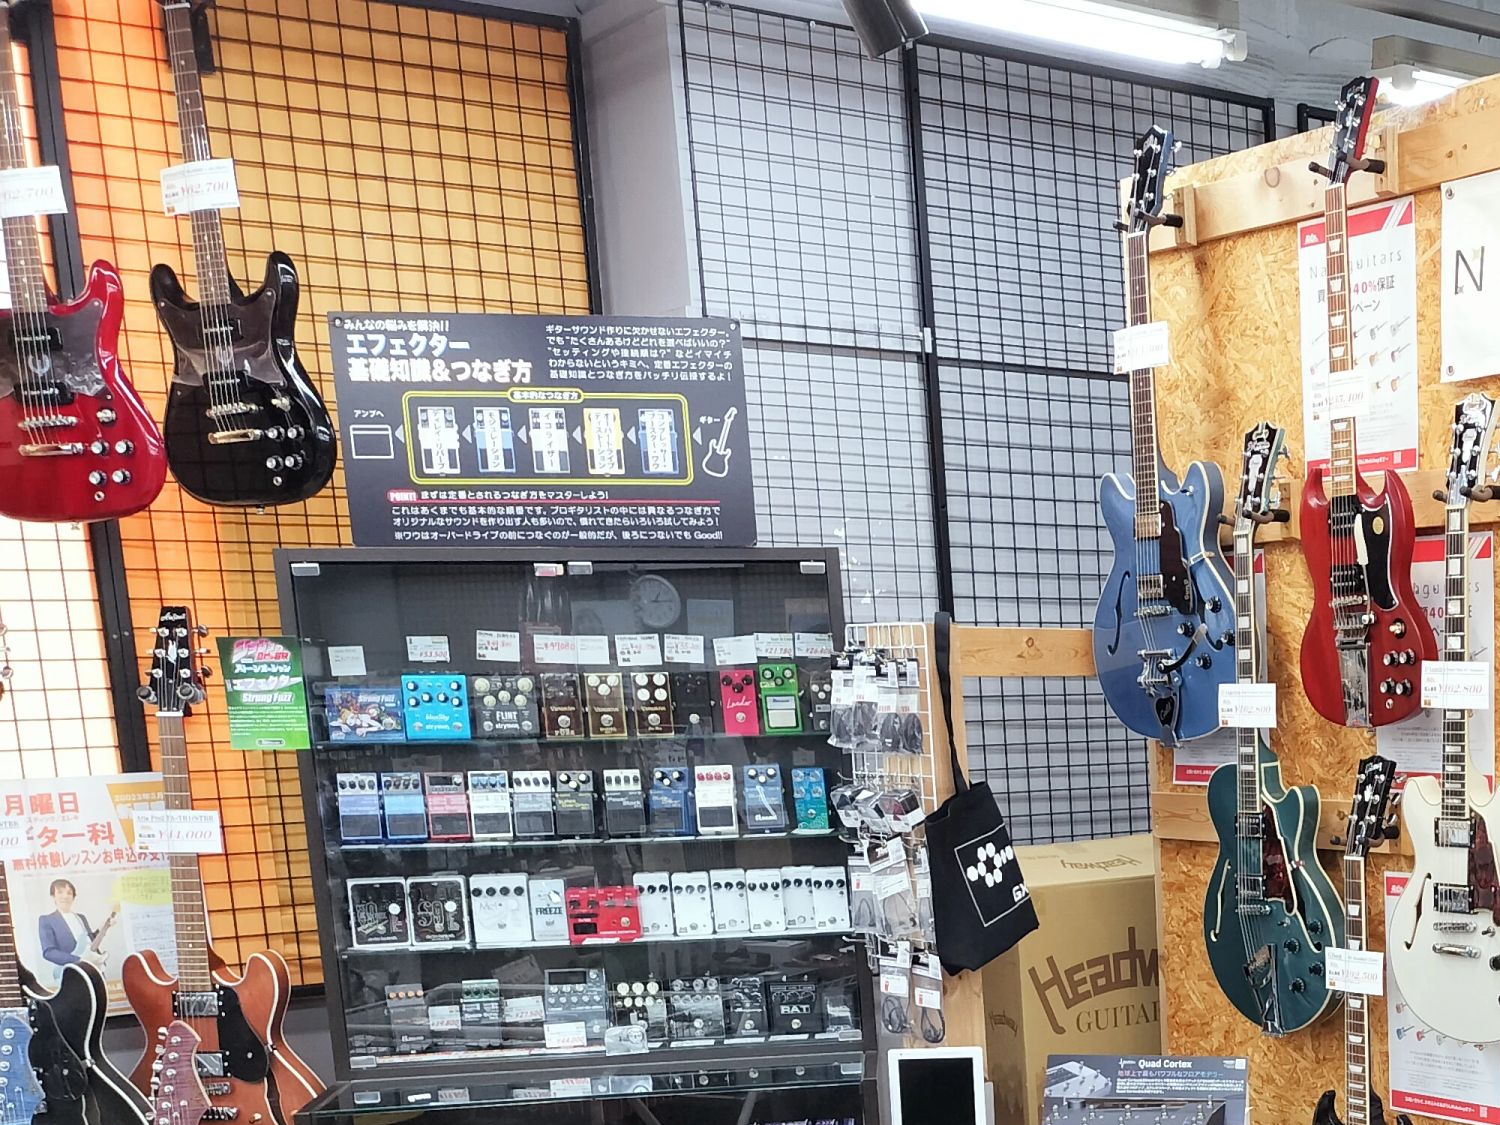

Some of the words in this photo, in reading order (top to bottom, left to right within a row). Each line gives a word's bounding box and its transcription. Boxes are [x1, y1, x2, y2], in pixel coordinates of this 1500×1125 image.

[346, 333, 471, 358] エフェクター
[348, 357, 533, 383] 基礎知識&つなぎ方
[353, 409, 384, 418] アンプへ
[496, 711, 518, 721] FLINT
[5, 791, 80, 817] 月曜日
[535, 906, 563, 915] FREEZE
[780, 1004, 811, 1014] RAT
[1138, 1059, 1162, 1069] Quad
[1163, 1059, 1193, 1069] Cortex
